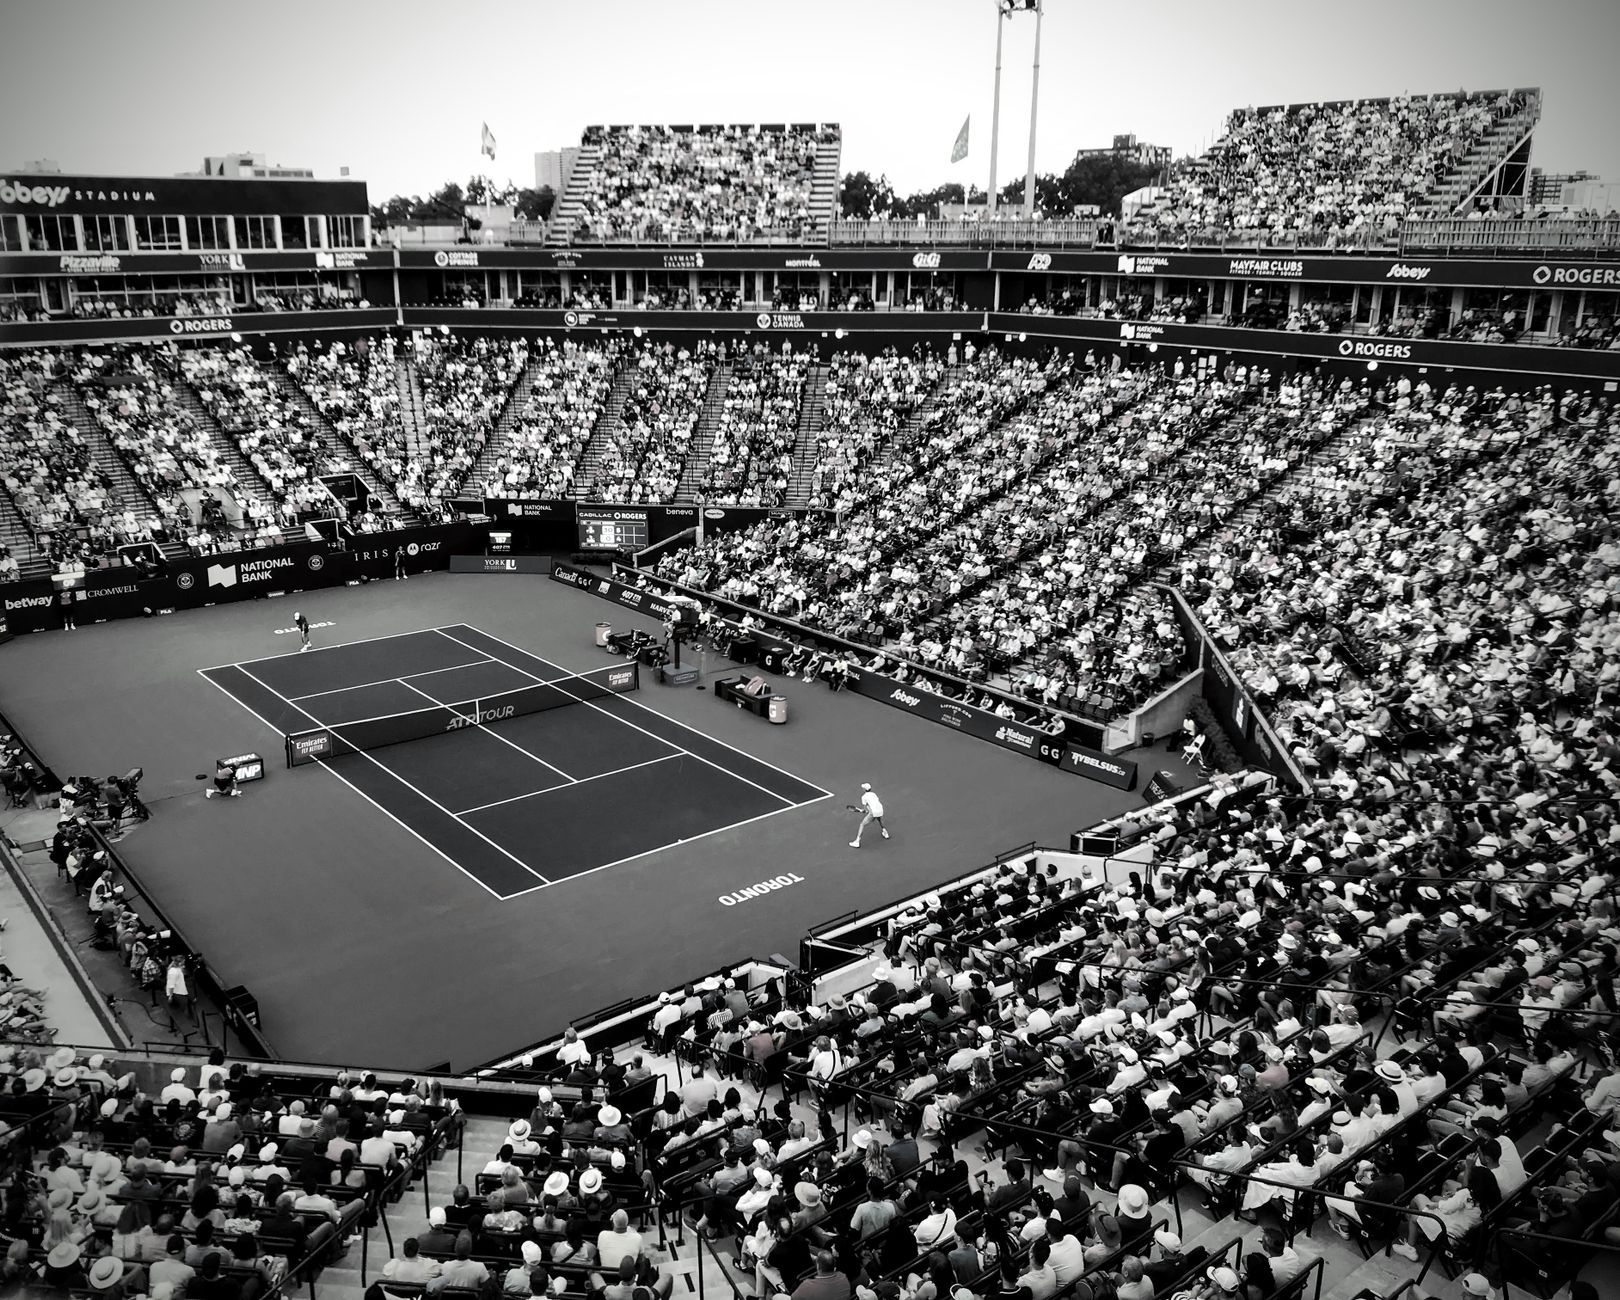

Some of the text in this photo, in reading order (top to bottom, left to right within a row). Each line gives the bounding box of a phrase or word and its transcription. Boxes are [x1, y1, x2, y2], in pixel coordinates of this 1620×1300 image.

[0, 179, 155, 207] obeys STADIUM
[60, 255, 121, 268] Pizzaville
[200, 254, 229, 264] YORK
[1136, 256, 1169, 266] NATIONAL
[1229, 259, 1303, 272] MAYFAIR CLUBS
[1136, 264, 1155, 273] BANK
[1386, 262, 1431, 280] Sobeys
[185, 318, 233, 332] ROGERS
[772, 314, 801, 322] TENNIS
[1136, 325, 1164, 334] NATIONAL
[1136, 332, 1152, 340] BANK
[1354, 342, 1411, 358] ROGERS
[665, 507, 694, 516] beneva
[420, 541, 441, 552] razr
[354, 549, 389, 562] IRIS
[240, 557, 295, 573] NATIONAL
[241, 570, 273, 583] BANK
[87, 584, 140, 598] CROMWELL
[5, 595, 54, 610] betway
[890, 689, 921, 706] Sobeys
[446, 705, 515, 731] ATP TOUR
[296, 736, 328, 750] Emirates
[1005, 727, 1034, 745] Natural
[235, 764, 261, 780] NP
[718, 872, 805, 906] TORONTO
